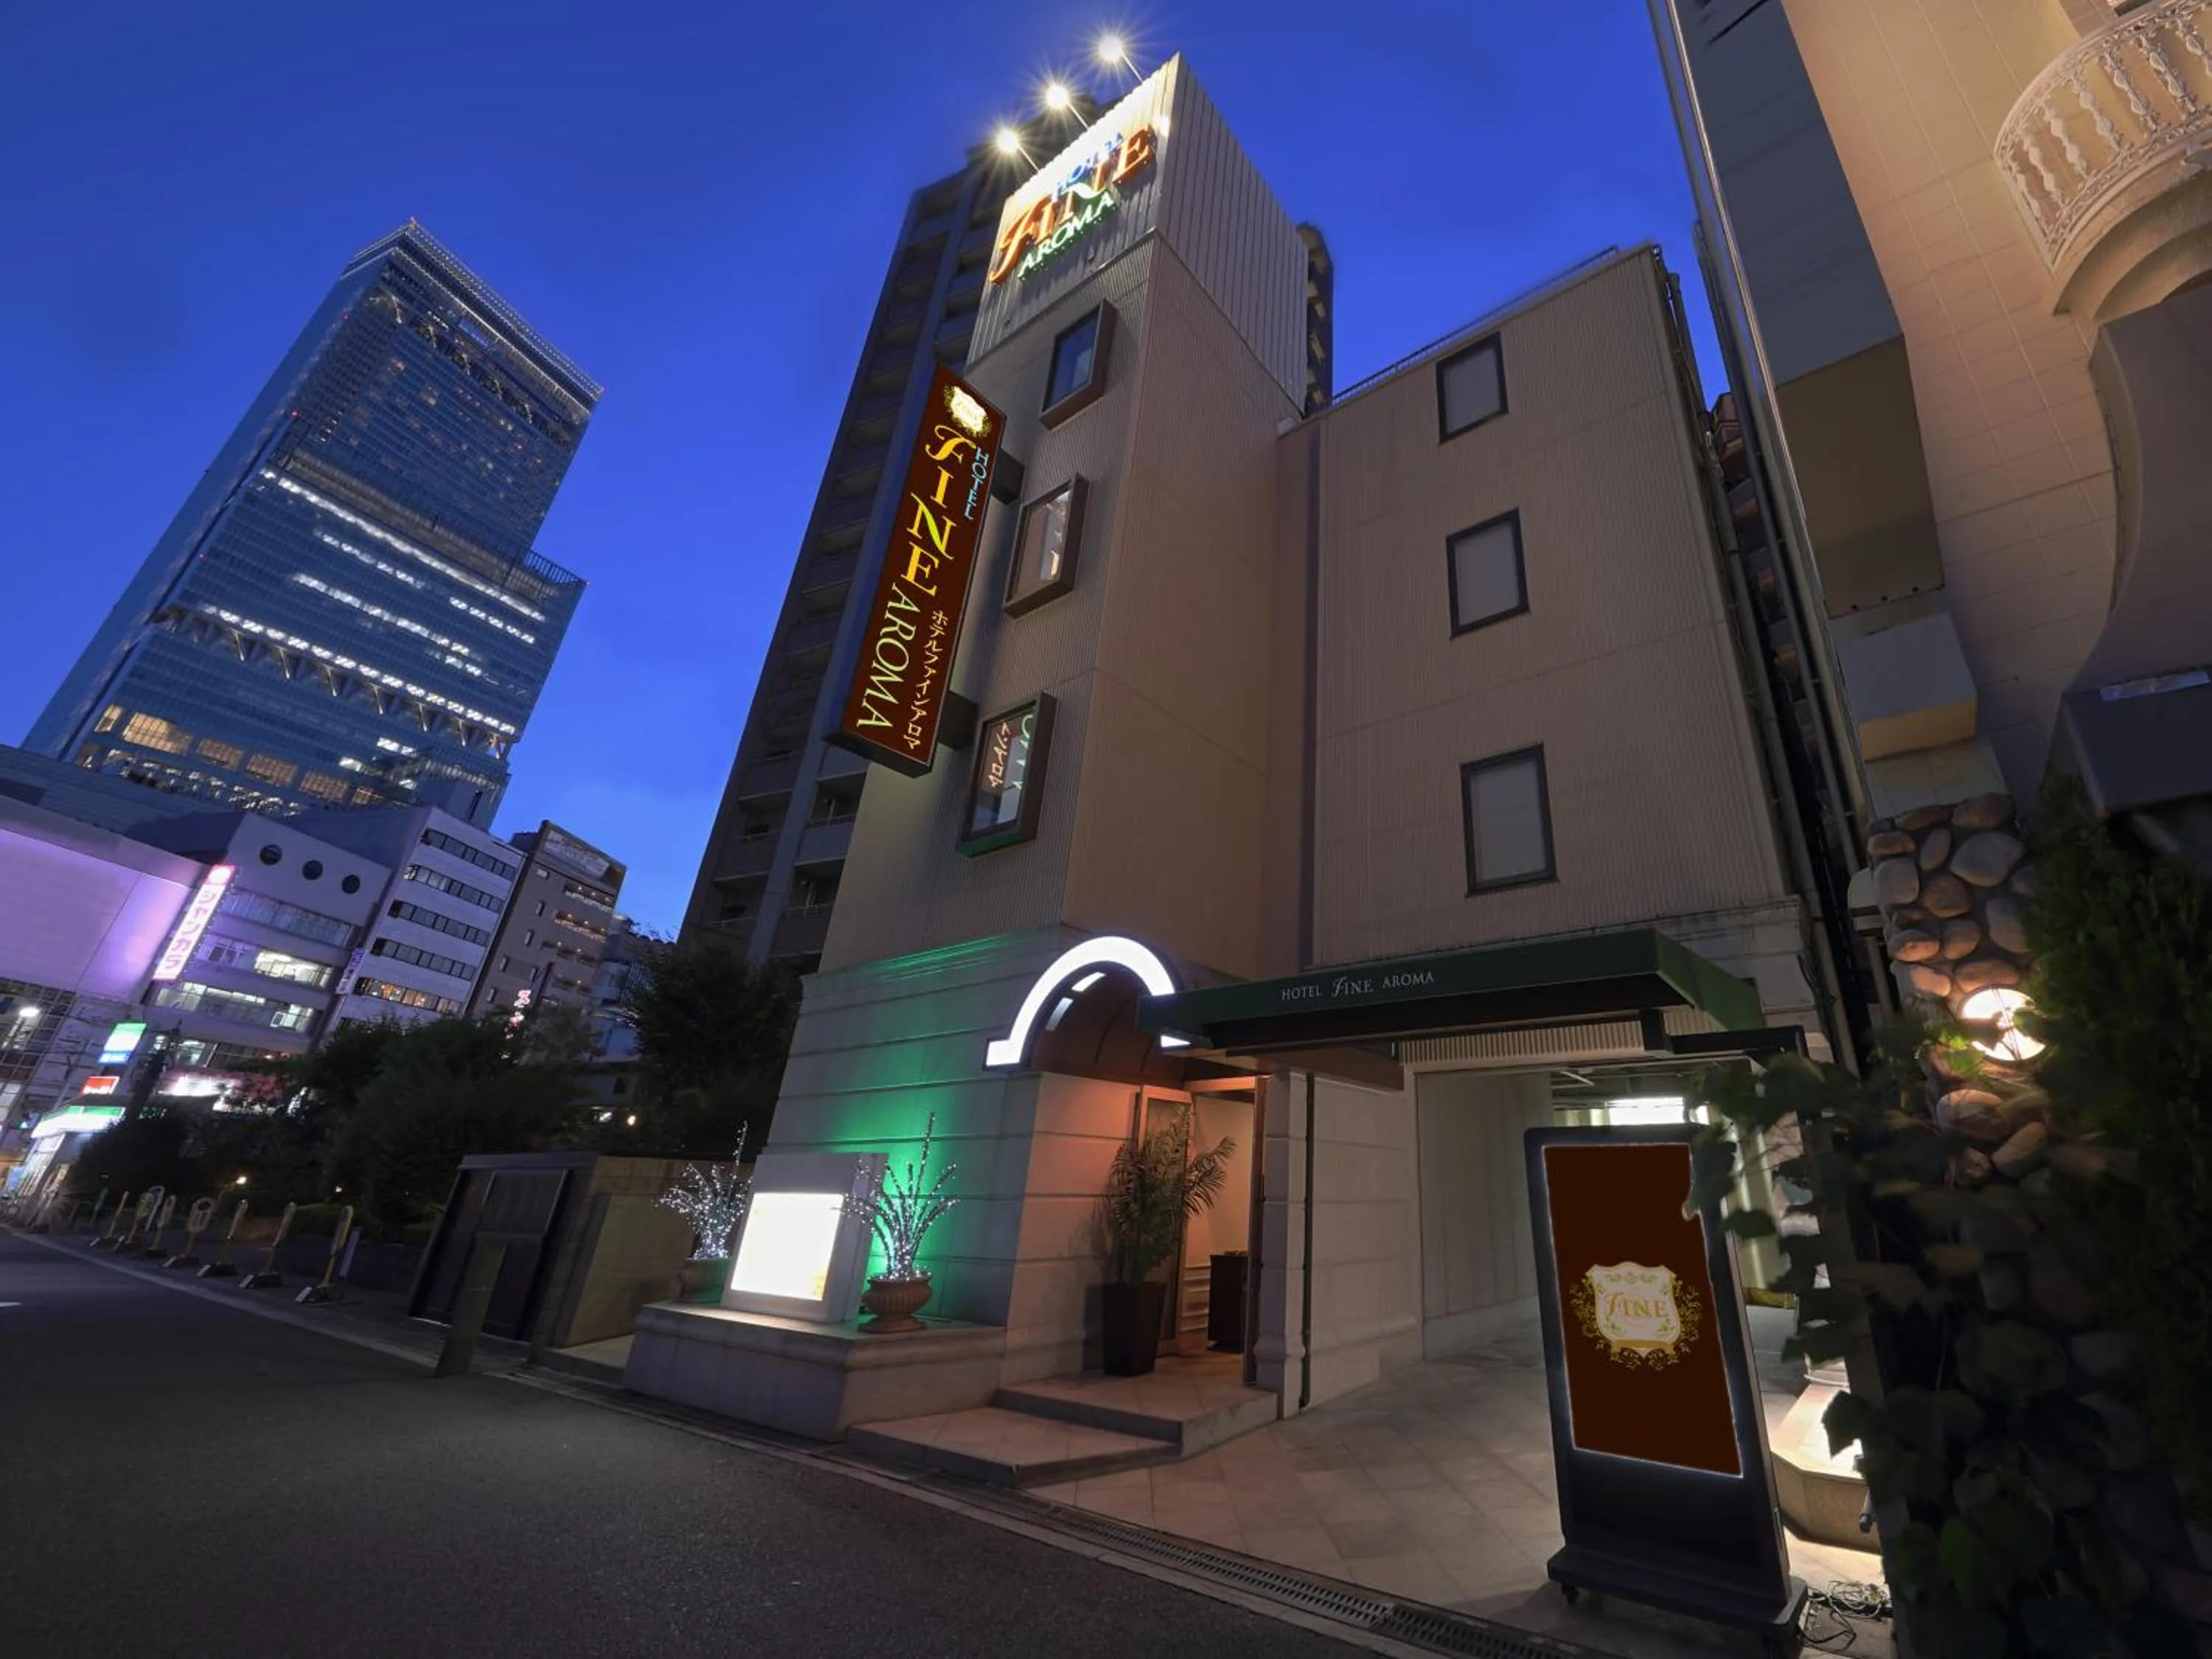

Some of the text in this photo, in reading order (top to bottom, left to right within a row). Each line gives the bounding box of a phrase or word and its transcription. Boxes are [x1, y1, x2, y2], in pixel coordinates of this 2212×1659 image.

[1018, 190, 1116, 278] AROMA
[900, 424, 977, 597] FINE
[964, 447, 990, 521] HOTEL
[856, 582, 921, 728] AROMA
[902, 610, 949, 750] ホテルファインアロマ
[1281, 970, 1434, 1001] HOTEL FINE AROMA
[1604, 1291, 1669, 1318] FINE
